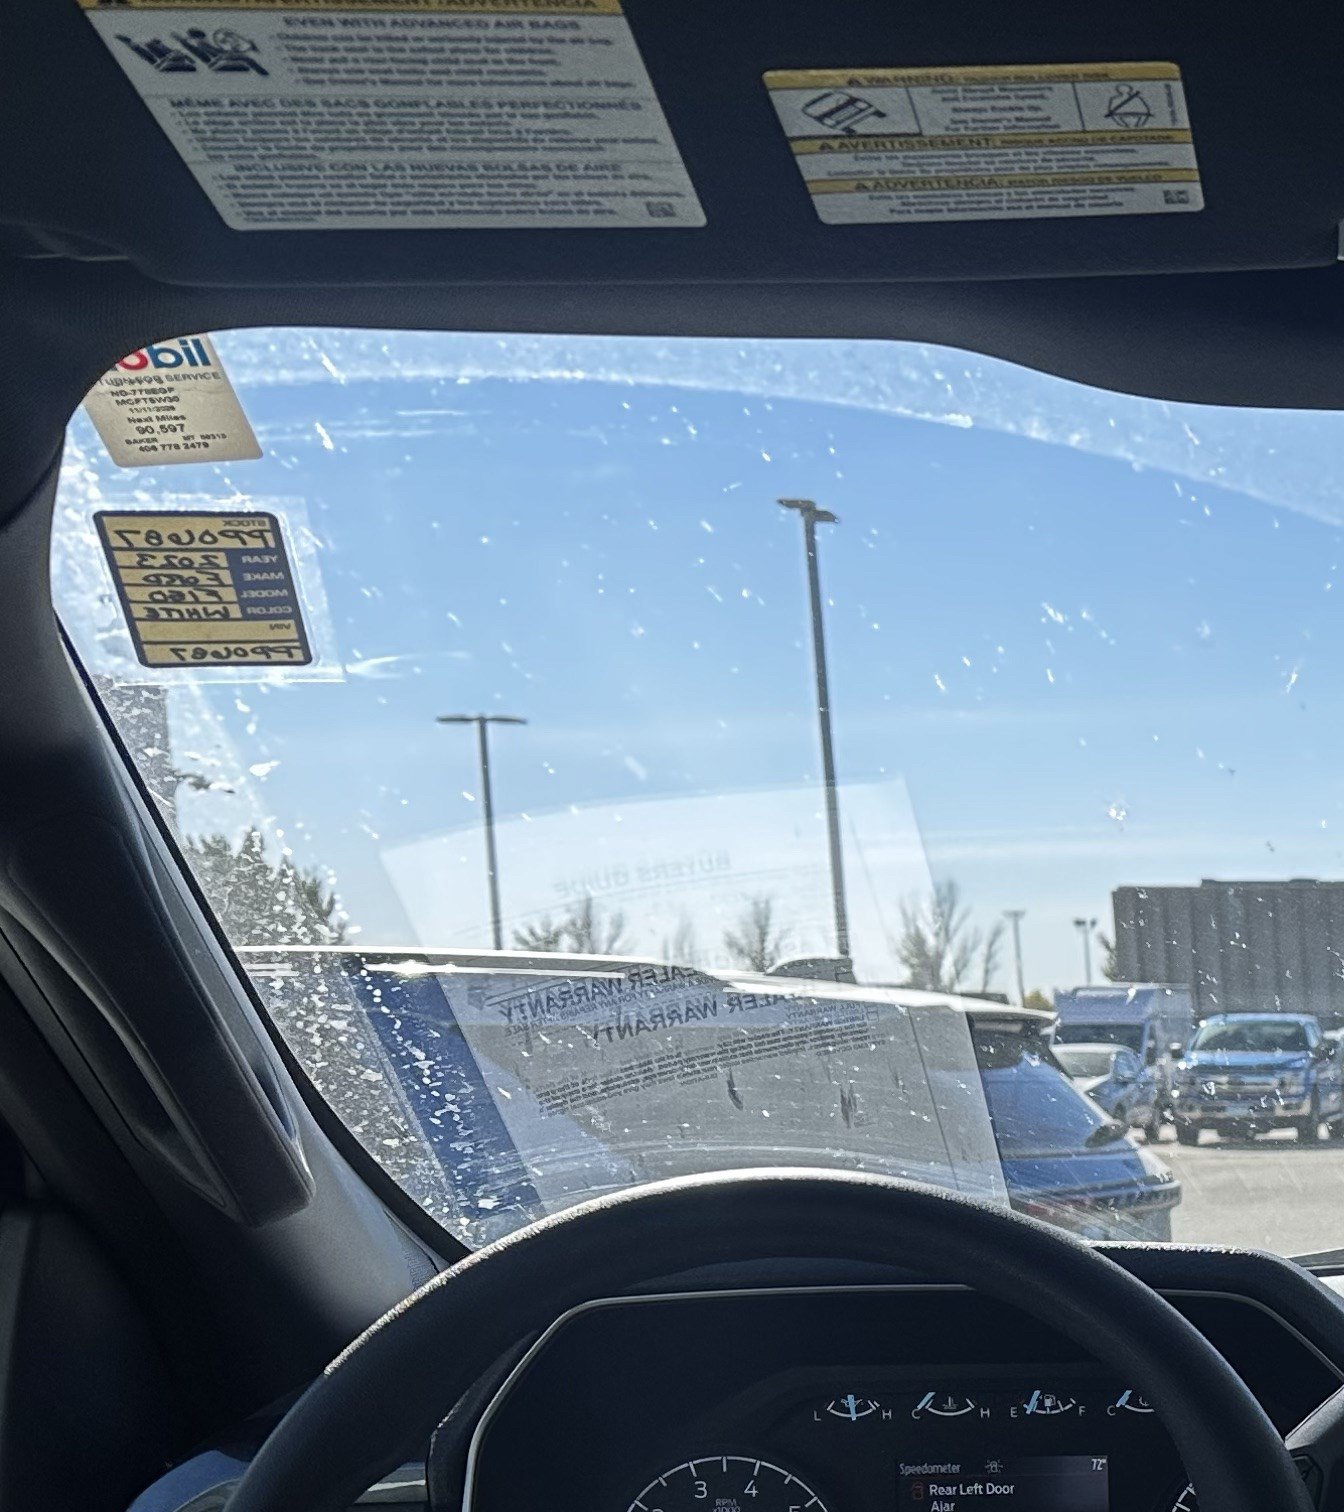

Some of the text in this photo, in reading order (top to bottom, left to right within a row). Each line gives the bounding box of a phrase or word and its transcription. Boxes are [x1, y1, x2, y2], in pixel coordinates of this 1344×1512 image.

[166, 371, 222, 383] SERVICE
[127, 414, 187, 425] Next Miles
[135, 423, 186, 436] 90,597
[183, 441, 210, 451] 2479
[813, 1410, 821, 1421] L
[881, 1409, 892, 1420] H
[981, 1408, 991, 1419] H
[1010, 1406, 1018, 1418] E
[1079, 1405, 1086, 1417] F
[1106, 1405, 1116, 1417] C
[899, 1462, 962, 1476] Speedometer
[694, 1480, 708, 1499] 3
[743, 1479, 759, 1497] 4
[929, 1481, 1015, 1496] Rear Left Door
[715, 1498, 738, 1508] RPM
